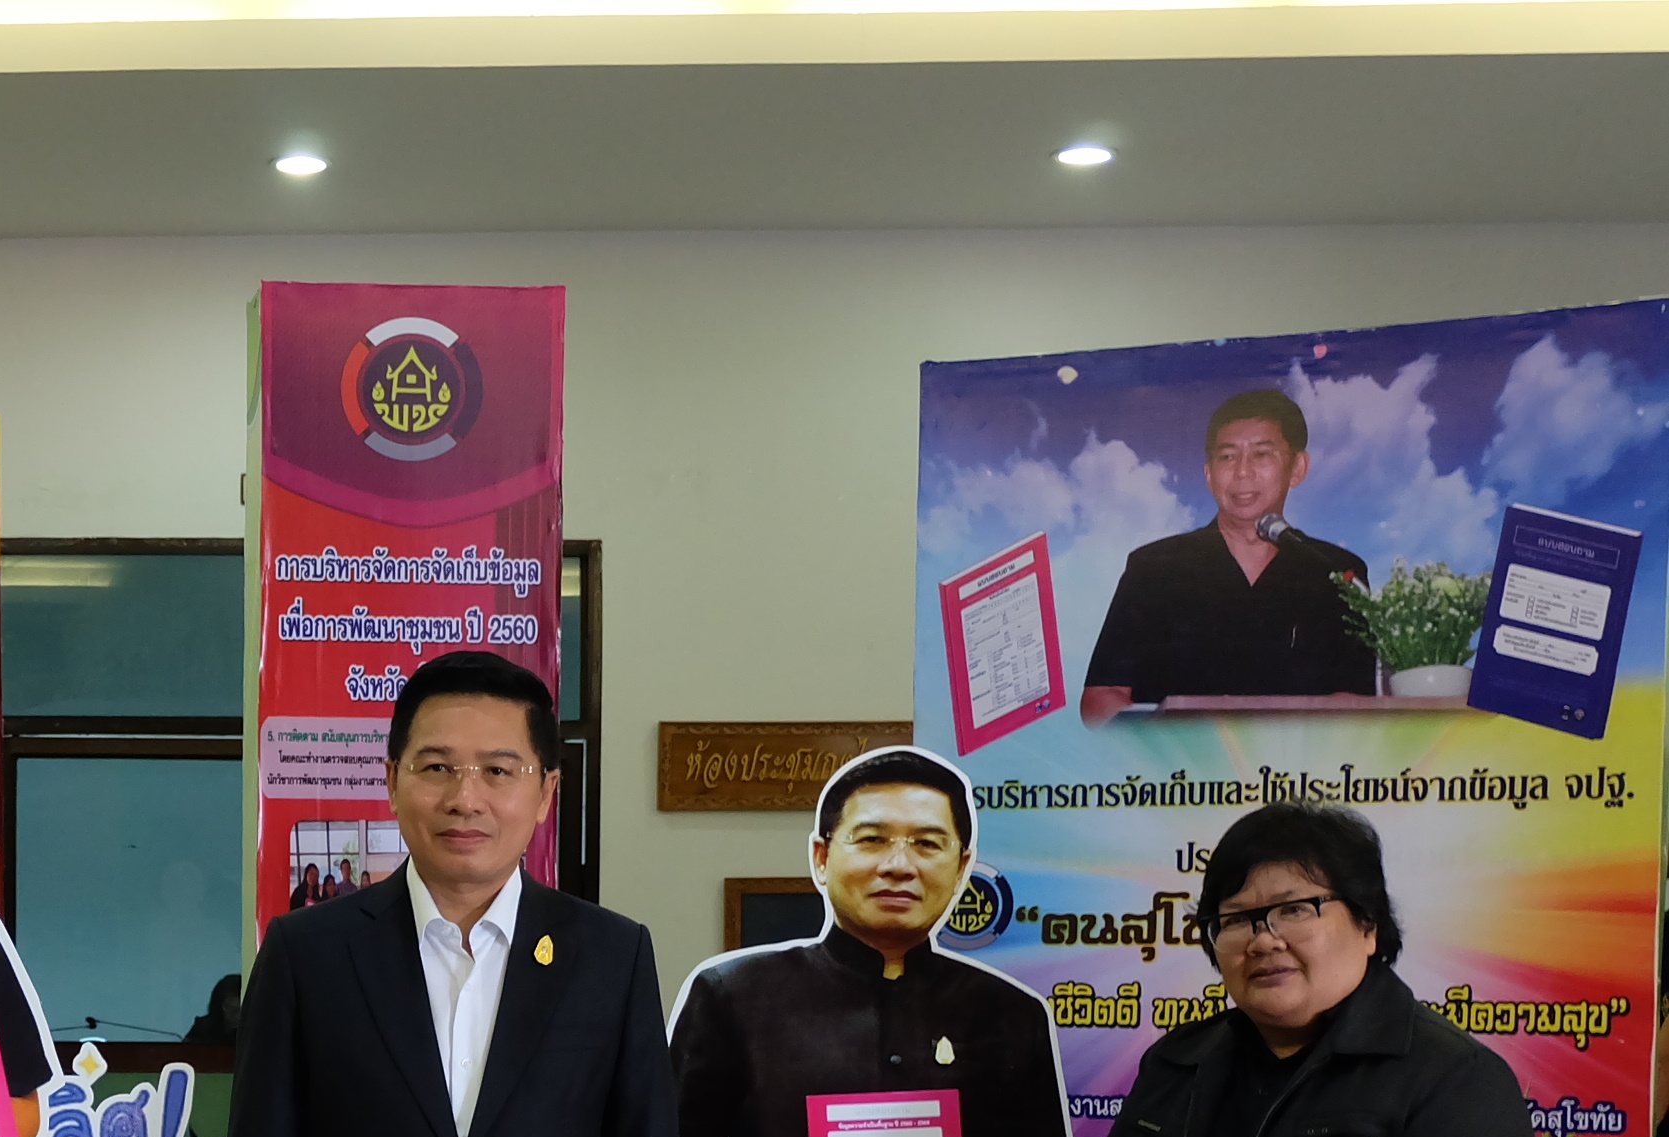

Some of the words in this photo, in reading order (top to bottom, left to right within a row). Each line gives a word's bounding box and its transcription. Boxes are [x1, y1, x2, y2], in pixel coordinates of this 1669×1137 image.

[276, 547, 540, 596] การบริหารจัดการจัดเก็บข้อมูล
[280, 599, 460, 653] เพื่อการพัฒนาชุมชน
[467, 608, 483, 641] ปี
[489, 617, 538, 642] 2560
[1564, 766, 1635, 808] จปฐ.
